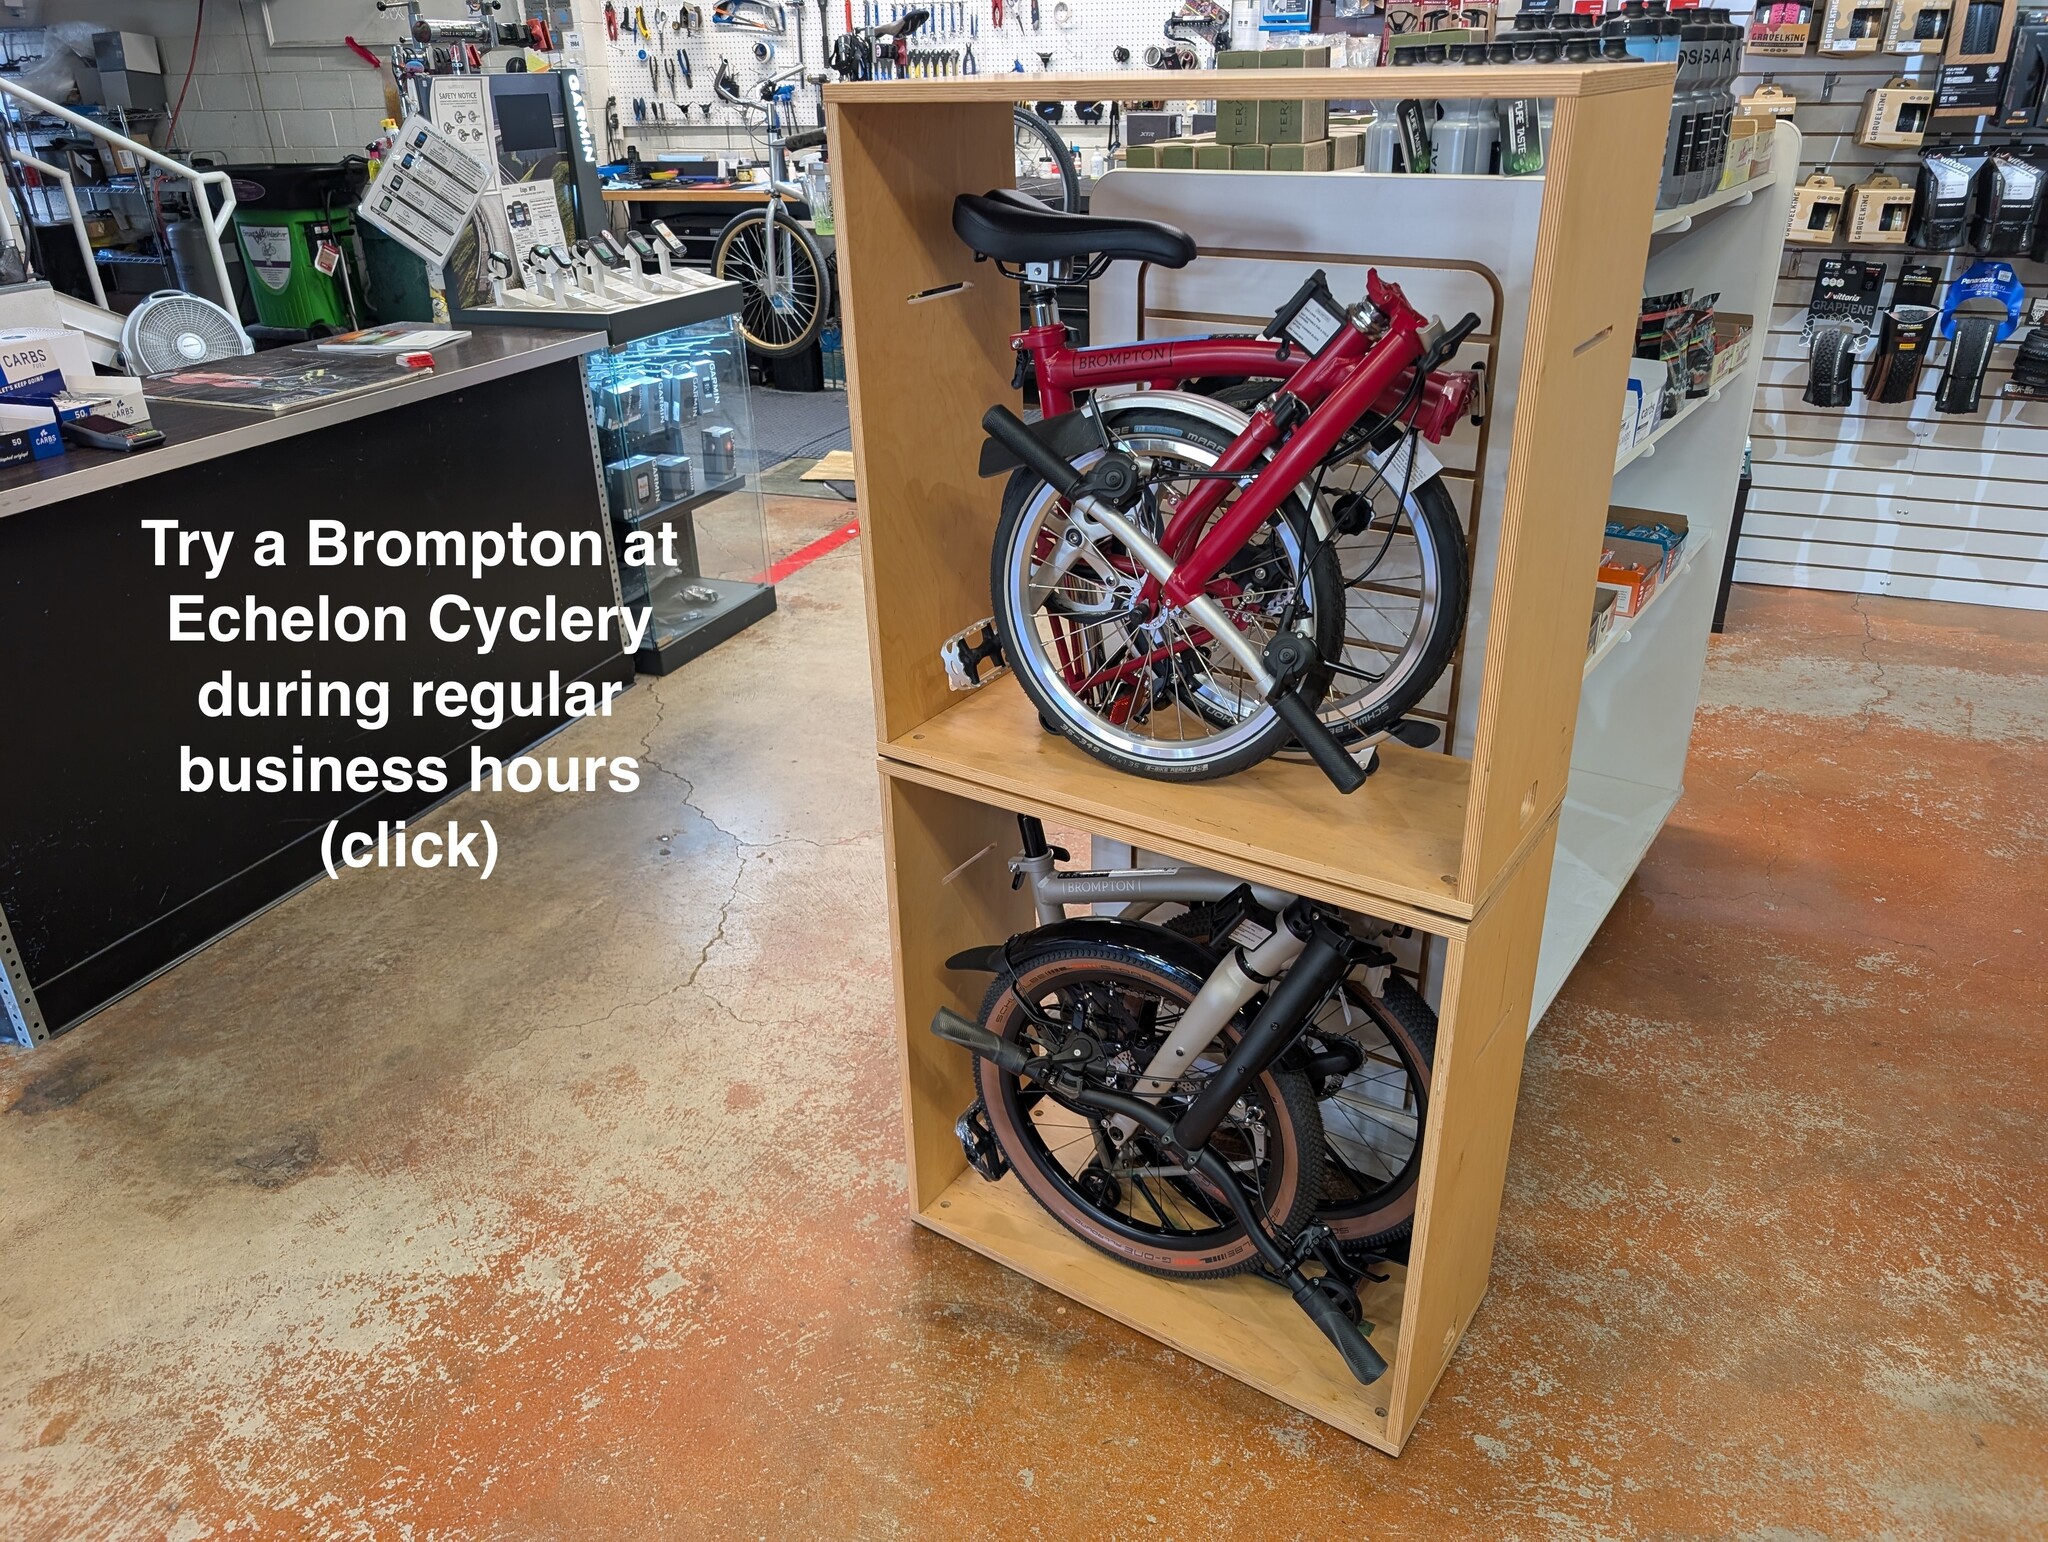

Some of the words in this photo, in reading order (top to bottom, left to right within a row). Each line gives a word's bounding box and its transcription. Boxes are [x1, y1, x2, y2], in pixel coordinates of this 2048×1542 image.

[1886, 0, 1904, 51] GRAVELKING
[1751, 33, 1806, 42] GRAVELKING
[439, 92, 456, 100] SAFETY
[568, 75, 595, 162] GARMIN
[1514, 100, 1525, 125] PURE
[1870, 93, 1887, 140] GRAVELKING
[1407, 108, 1420, 130] PURE
[1414, 133, 1423, 158] TASTE
[1516, 126, 1527, 155] TASTE
[442, 139, 470, 160] Assortment
[467, 156, 482, 170] Guide
[1940, 156, 1973, 174] vittoria
[2007, 155, 2040, 175] vittoria
[1855, 194, 1870, 240] GRAVELKING
[1811, 300, 1875, 316] GRAPHENE
[1833, 293, 1861, 302] vittoria
[3, 349, 47, 368] CARBS
[1079, 347, 1165, 370] BROMPTON
[14, 380, 27, 389] KEEP
[28, 376, 44, 386] GOING
[709, 363, 720, 404] GARMIN
[111, 406, 134, 419] CARBS
[657, 382, 665, 424] GARMIN
[12, 437, 22, 447] 50
[36, 434, 57, 446] CARBS
[652, 459, 661, 503] GARMIN
[1060, 724, 1100, 754] 35-349
[1068, 880, 1135, 893] BROMPTON
[1074, 1217, 1123, 1250] ALLROUND
[1125, 1246, 1172, 1265] G-ONE
